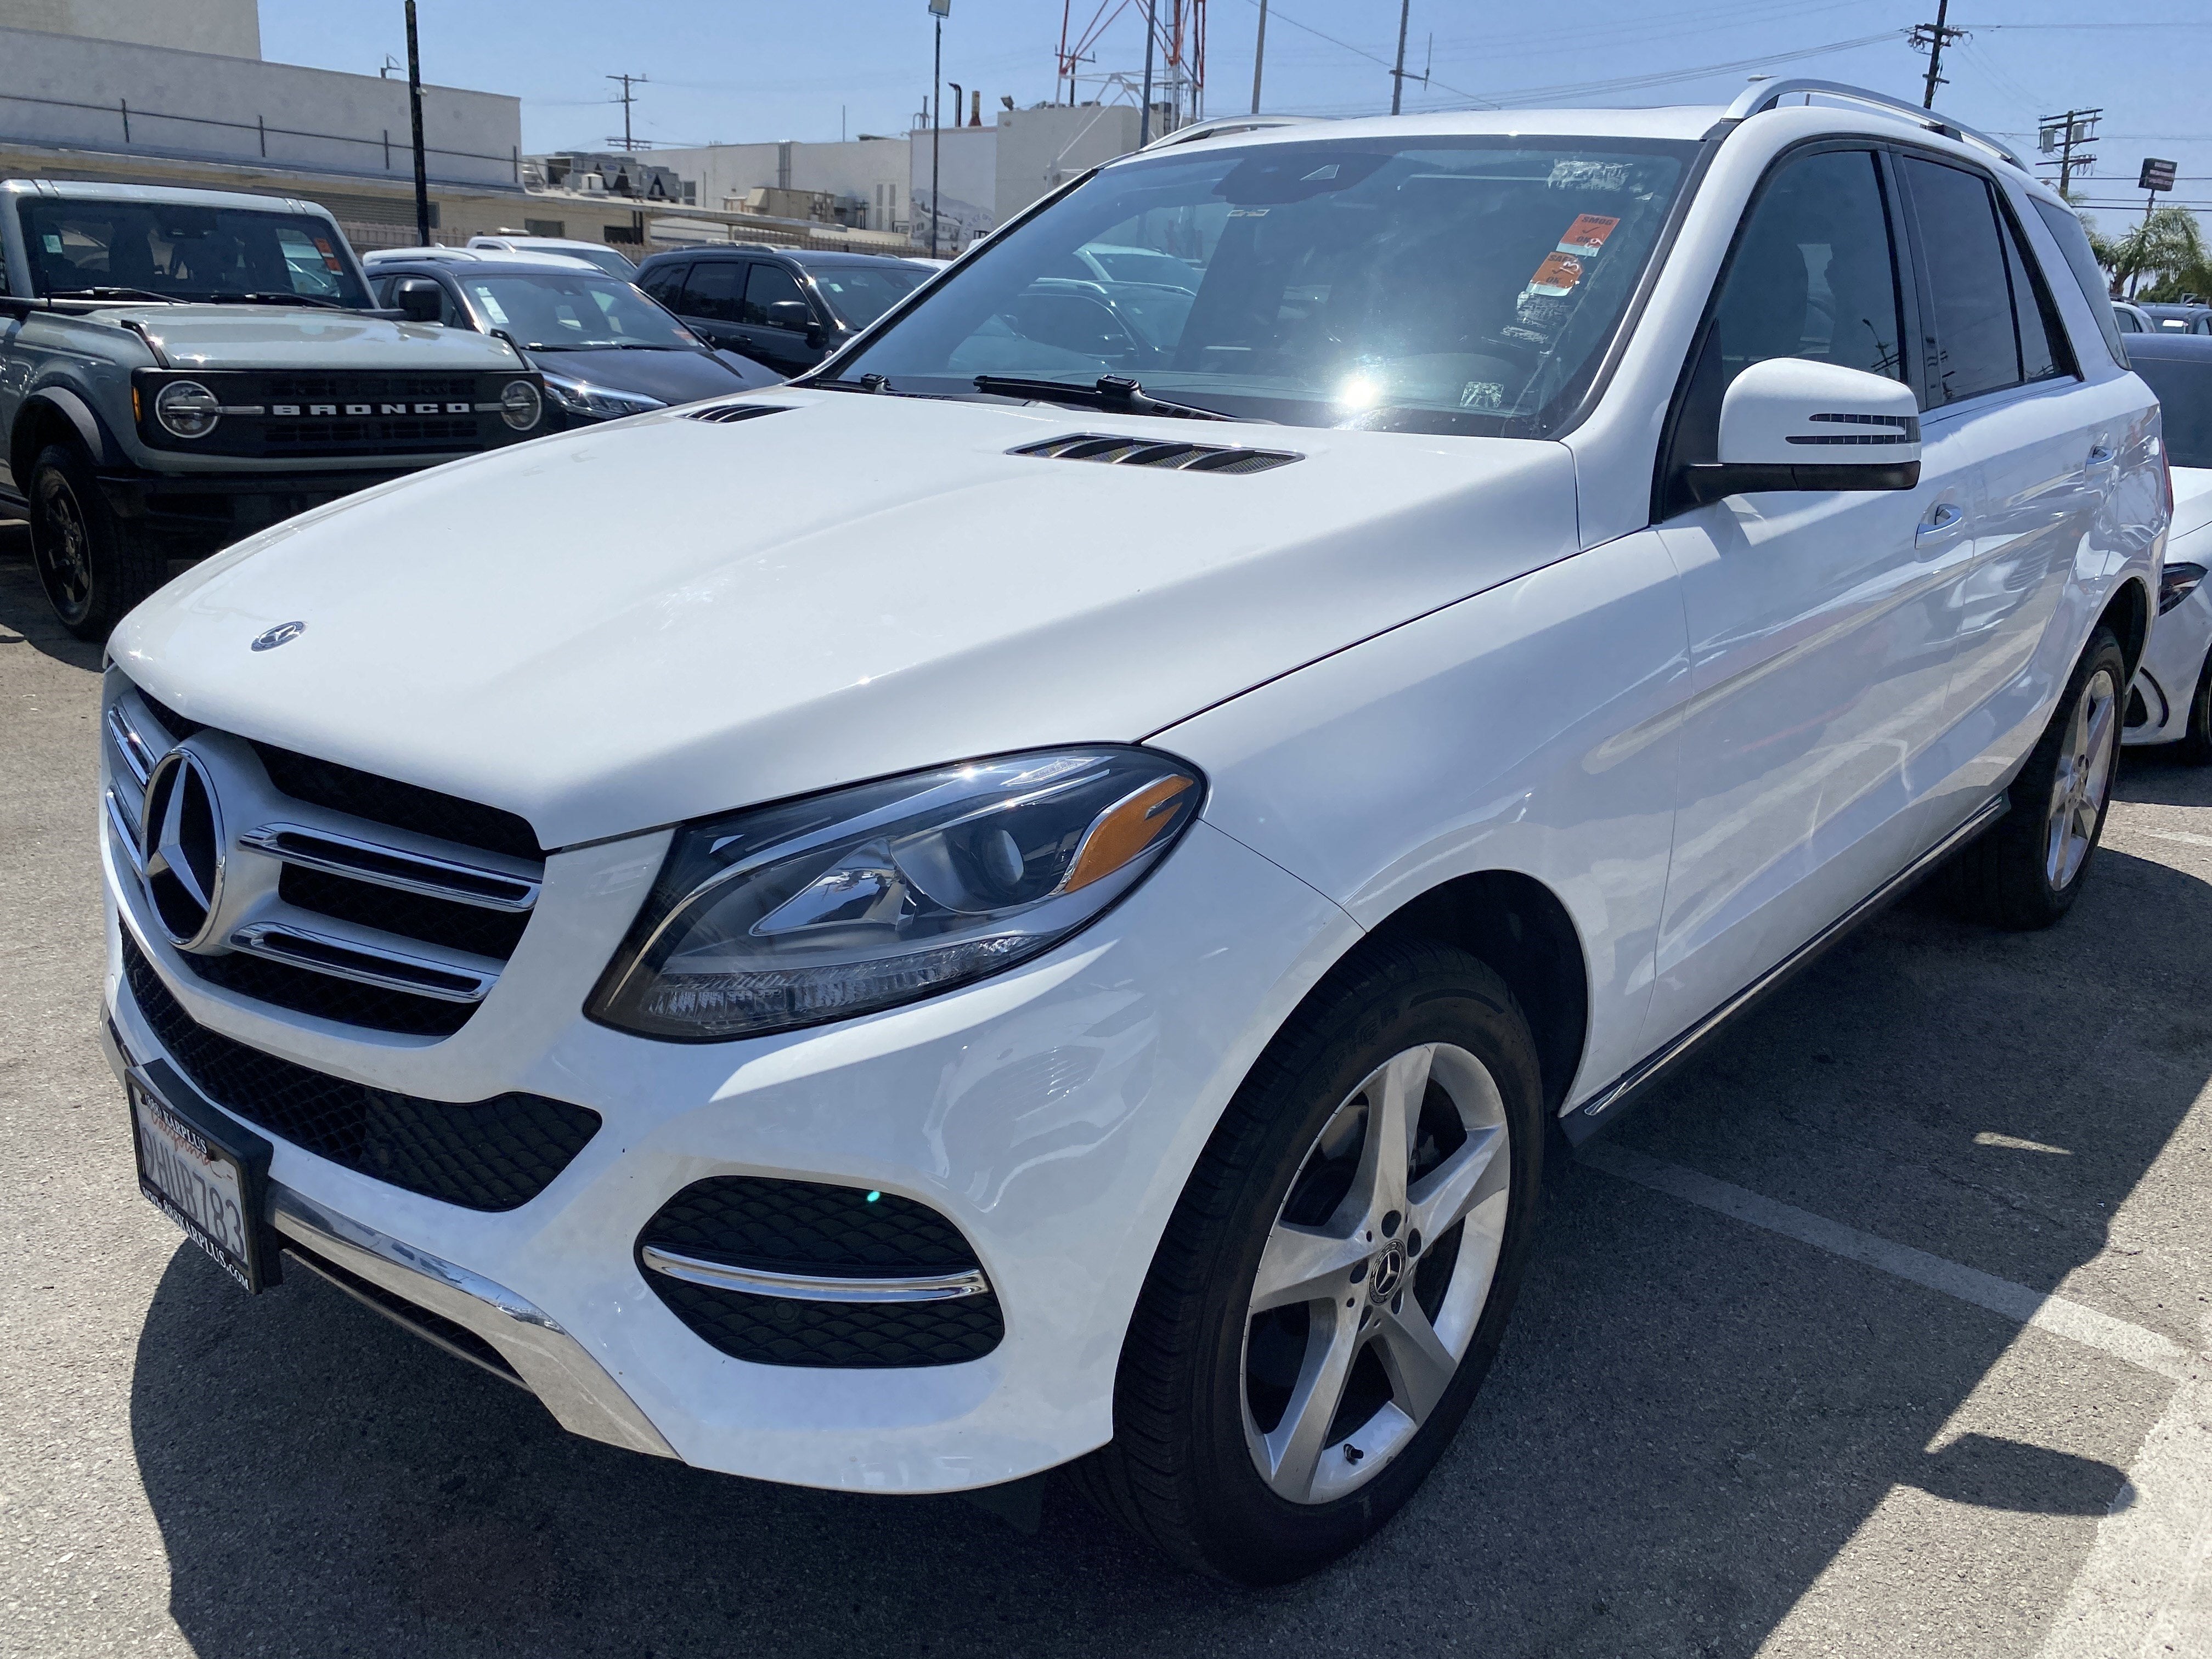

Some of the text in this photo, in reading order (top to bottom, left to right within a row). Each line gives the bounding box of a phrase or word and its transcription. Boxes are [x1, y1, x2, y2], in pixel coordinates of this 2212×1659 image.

[1582, 216, 1613, 225] SMOG
[273, 403, 470, 415] BRONCO
[162, 1109, 207, 1154] KARPLUS
[140, 1127, 245, 1261] 9HUB783
